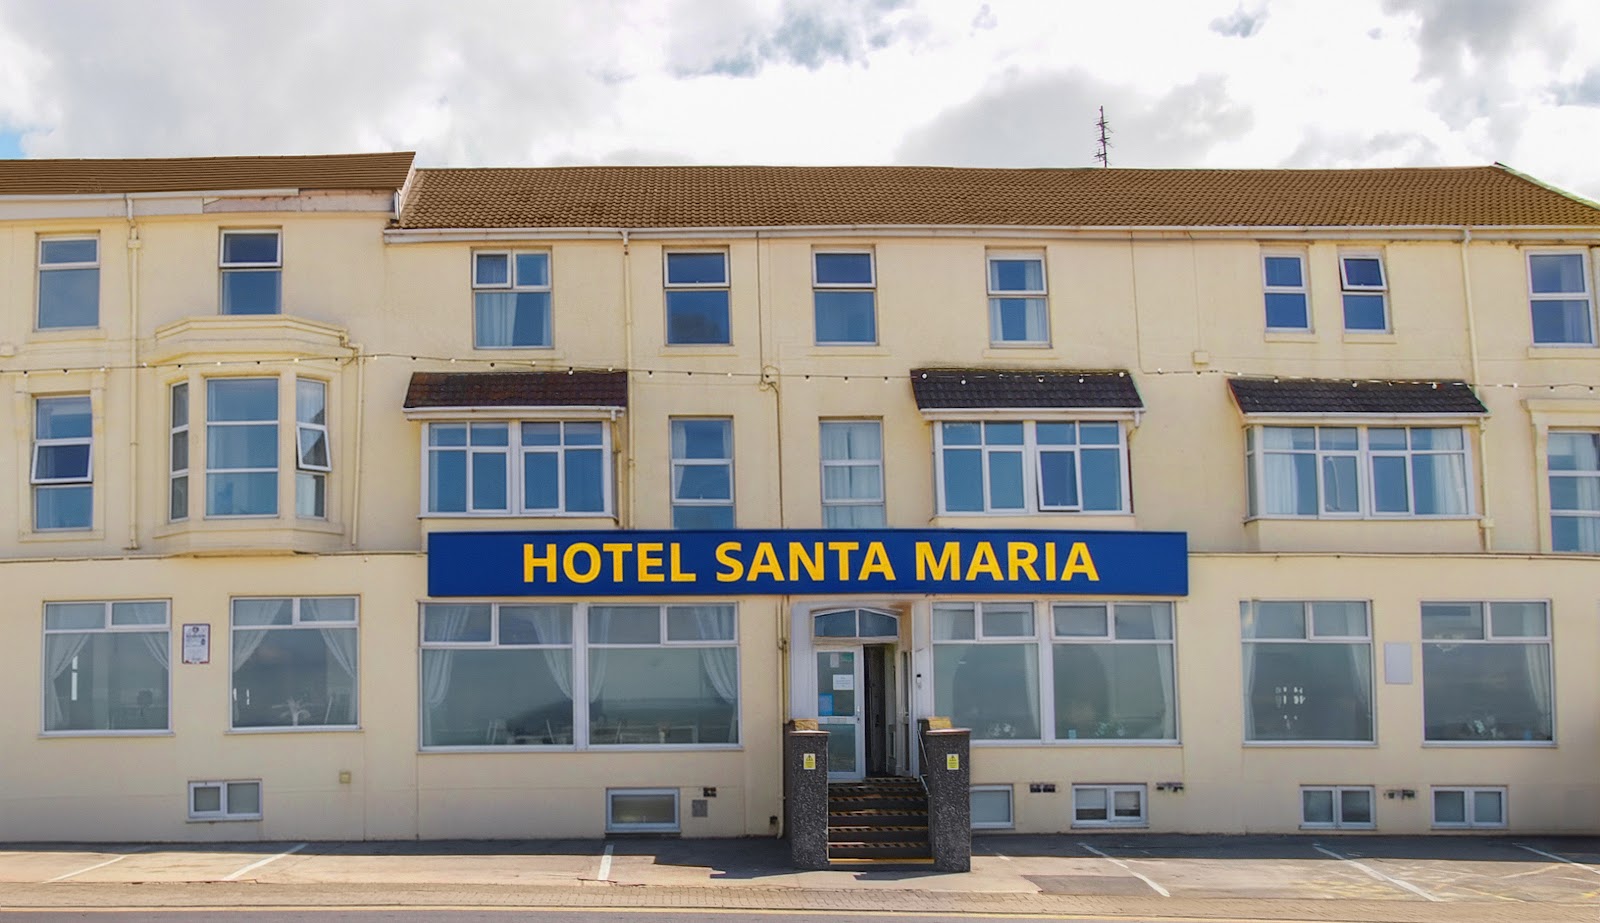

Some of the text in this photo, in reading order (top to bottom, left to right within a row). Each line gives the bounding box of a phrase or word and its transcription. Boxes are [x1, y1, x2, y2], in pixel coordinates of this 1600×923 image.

[523, 542, 1100, 583] HOTEL SANTA MARIA
